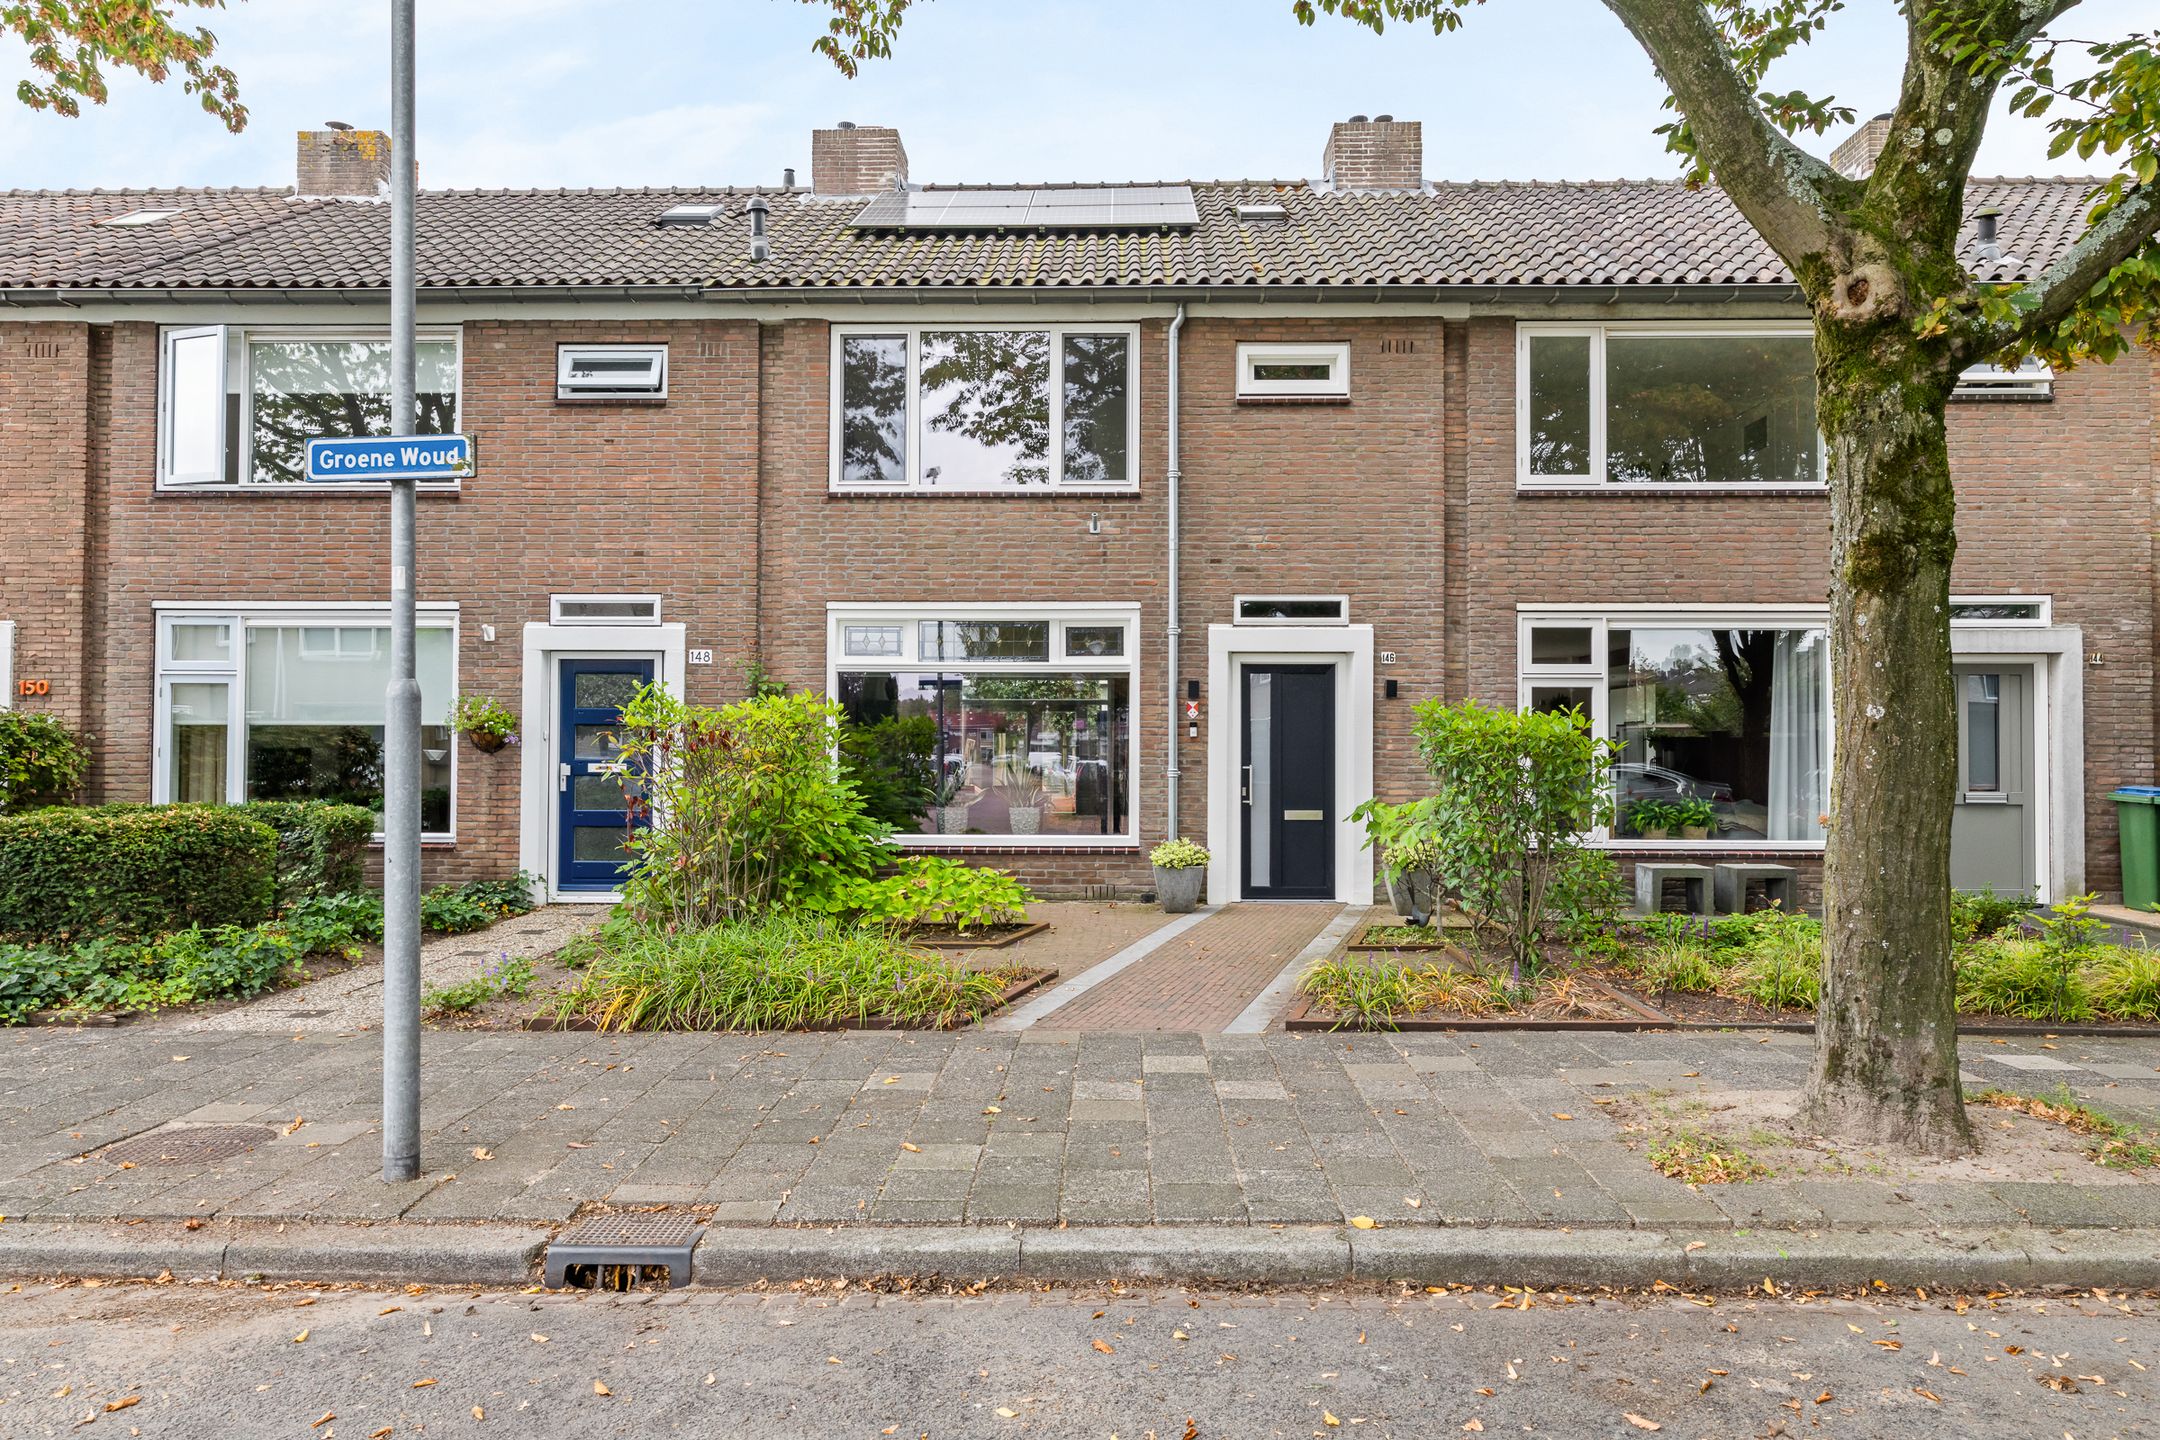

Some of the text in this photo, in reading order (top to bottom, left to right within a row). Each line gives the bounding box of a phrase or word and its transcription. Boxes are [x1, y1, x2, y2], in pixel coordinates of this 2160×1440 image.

[319, 446, 459, 469] Groene Woud
[690, 651, 711, 662] 148
[1382, 653, 1395, 662] 146
[18, 680, 49, 695] 150
